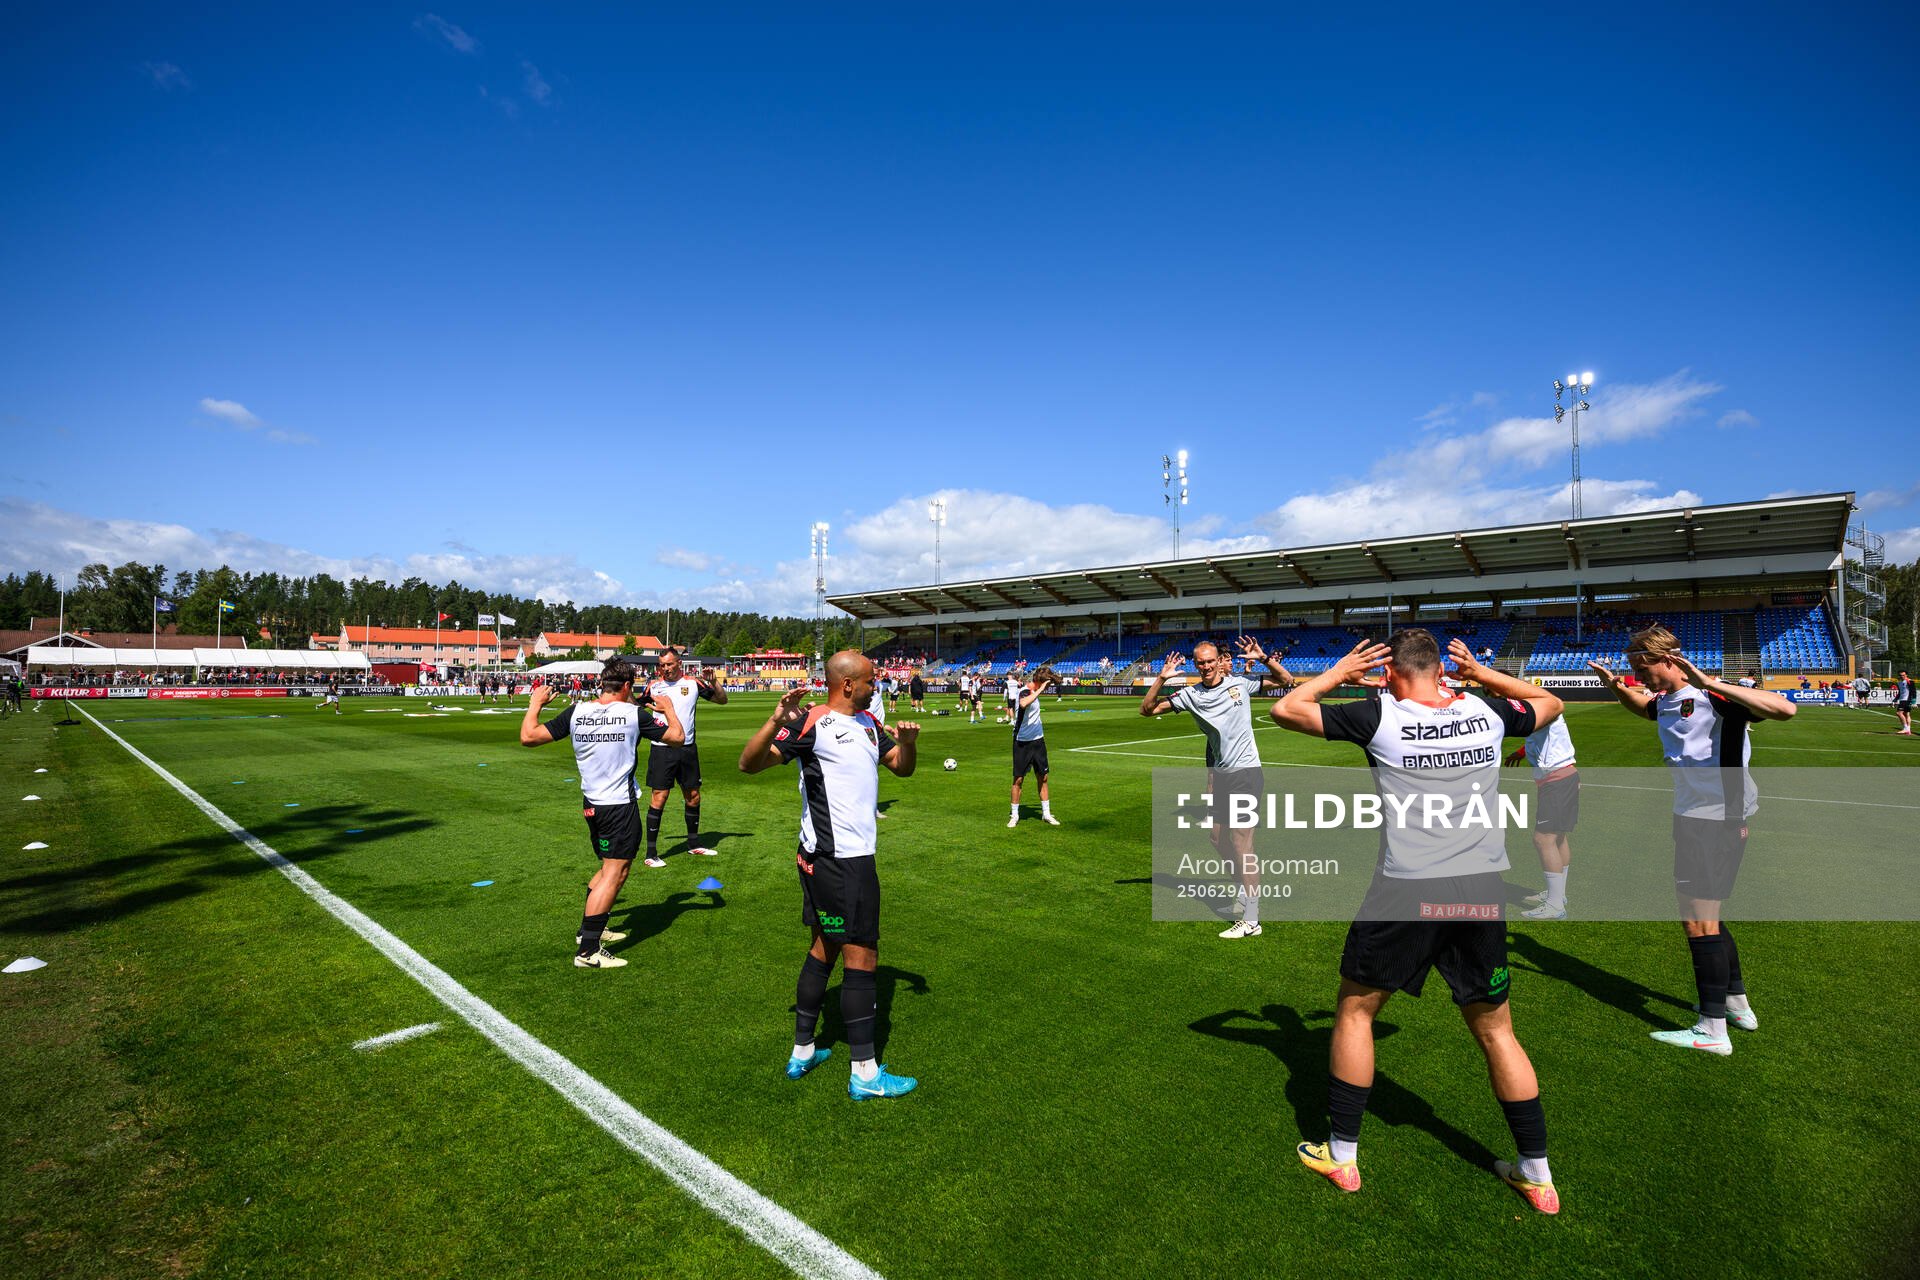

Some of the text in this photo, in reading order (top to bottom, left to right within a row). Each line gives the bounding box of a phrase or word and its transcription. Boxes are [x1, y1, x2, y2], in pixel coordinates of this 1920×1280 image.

[51, 689, 90, 697] KULTUR
[414, 687, 449, 696] GAAM
[1103, 687, 1133, 695] UNIBET
[1233, 700, 1243, 708] AS
[575, 715, 627, 726] stadium
[1401, 715, 1490, 741] stadium
[573, 733, 626, 743] BAUHAUS
[1403, 746, 1495, 770] BAUHAUS
[1420, 902, 1500, 920] BAUHAUS
